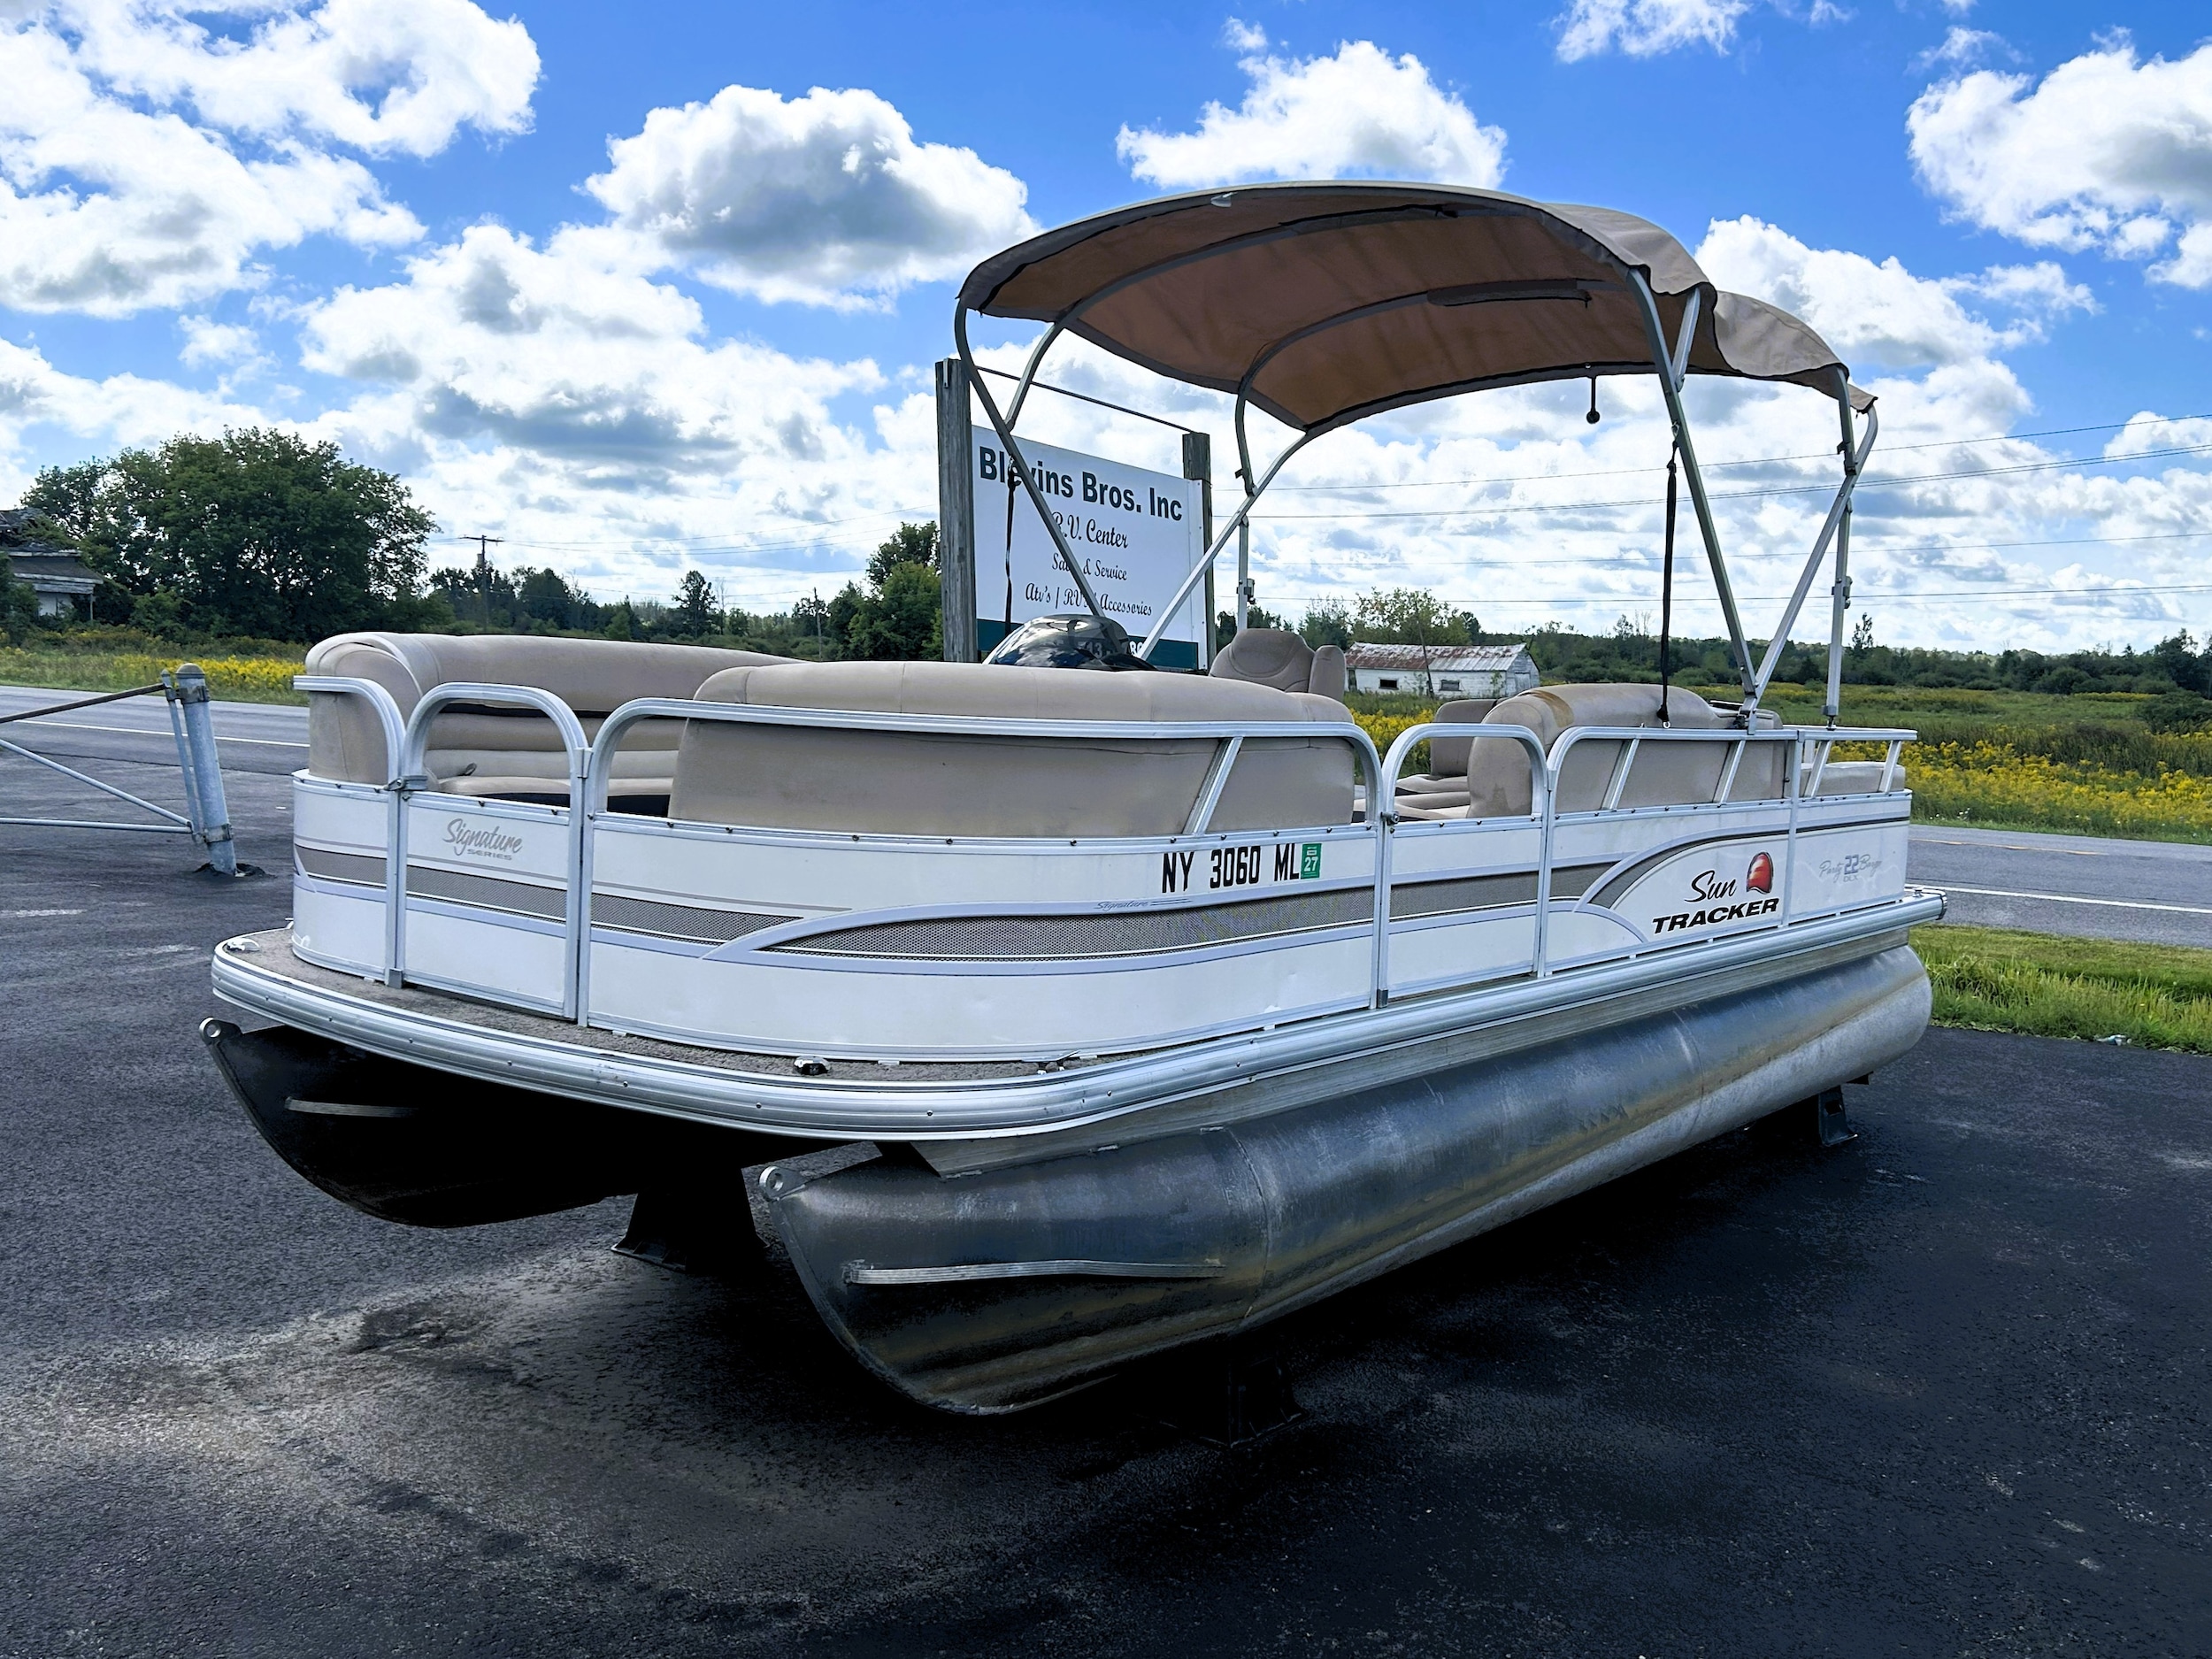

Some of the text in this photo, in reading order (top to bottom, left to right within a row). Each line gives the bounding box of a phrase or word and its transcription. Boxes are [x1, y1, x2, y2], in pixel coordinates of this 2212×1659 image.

[1082, 471, 1141, 513] Bros.
[1149, 487, 1183, 521] Inc
[1086, 518, 1128, 549] Center
[1083, 557, 1092, 575] &
[1094, 559, 1127, 580] Service
[1025, 582, 1051, 603] Atv's
[1100, 593, 1152, 616] Accessories
[442, 818, 523, 856] Signature
[466, 848, 513, 861] SERIES
[1162, 842, 1300, 893] NY 3060 ML
[1303, 856, 1318, 872] 27
[1844, 854, 1859, 875] 22
[1684, 869, 1737, 902] Sun
[1094, 900, 1148, 912] Signature
[1652, 897, 1779, 933] TRACKER
